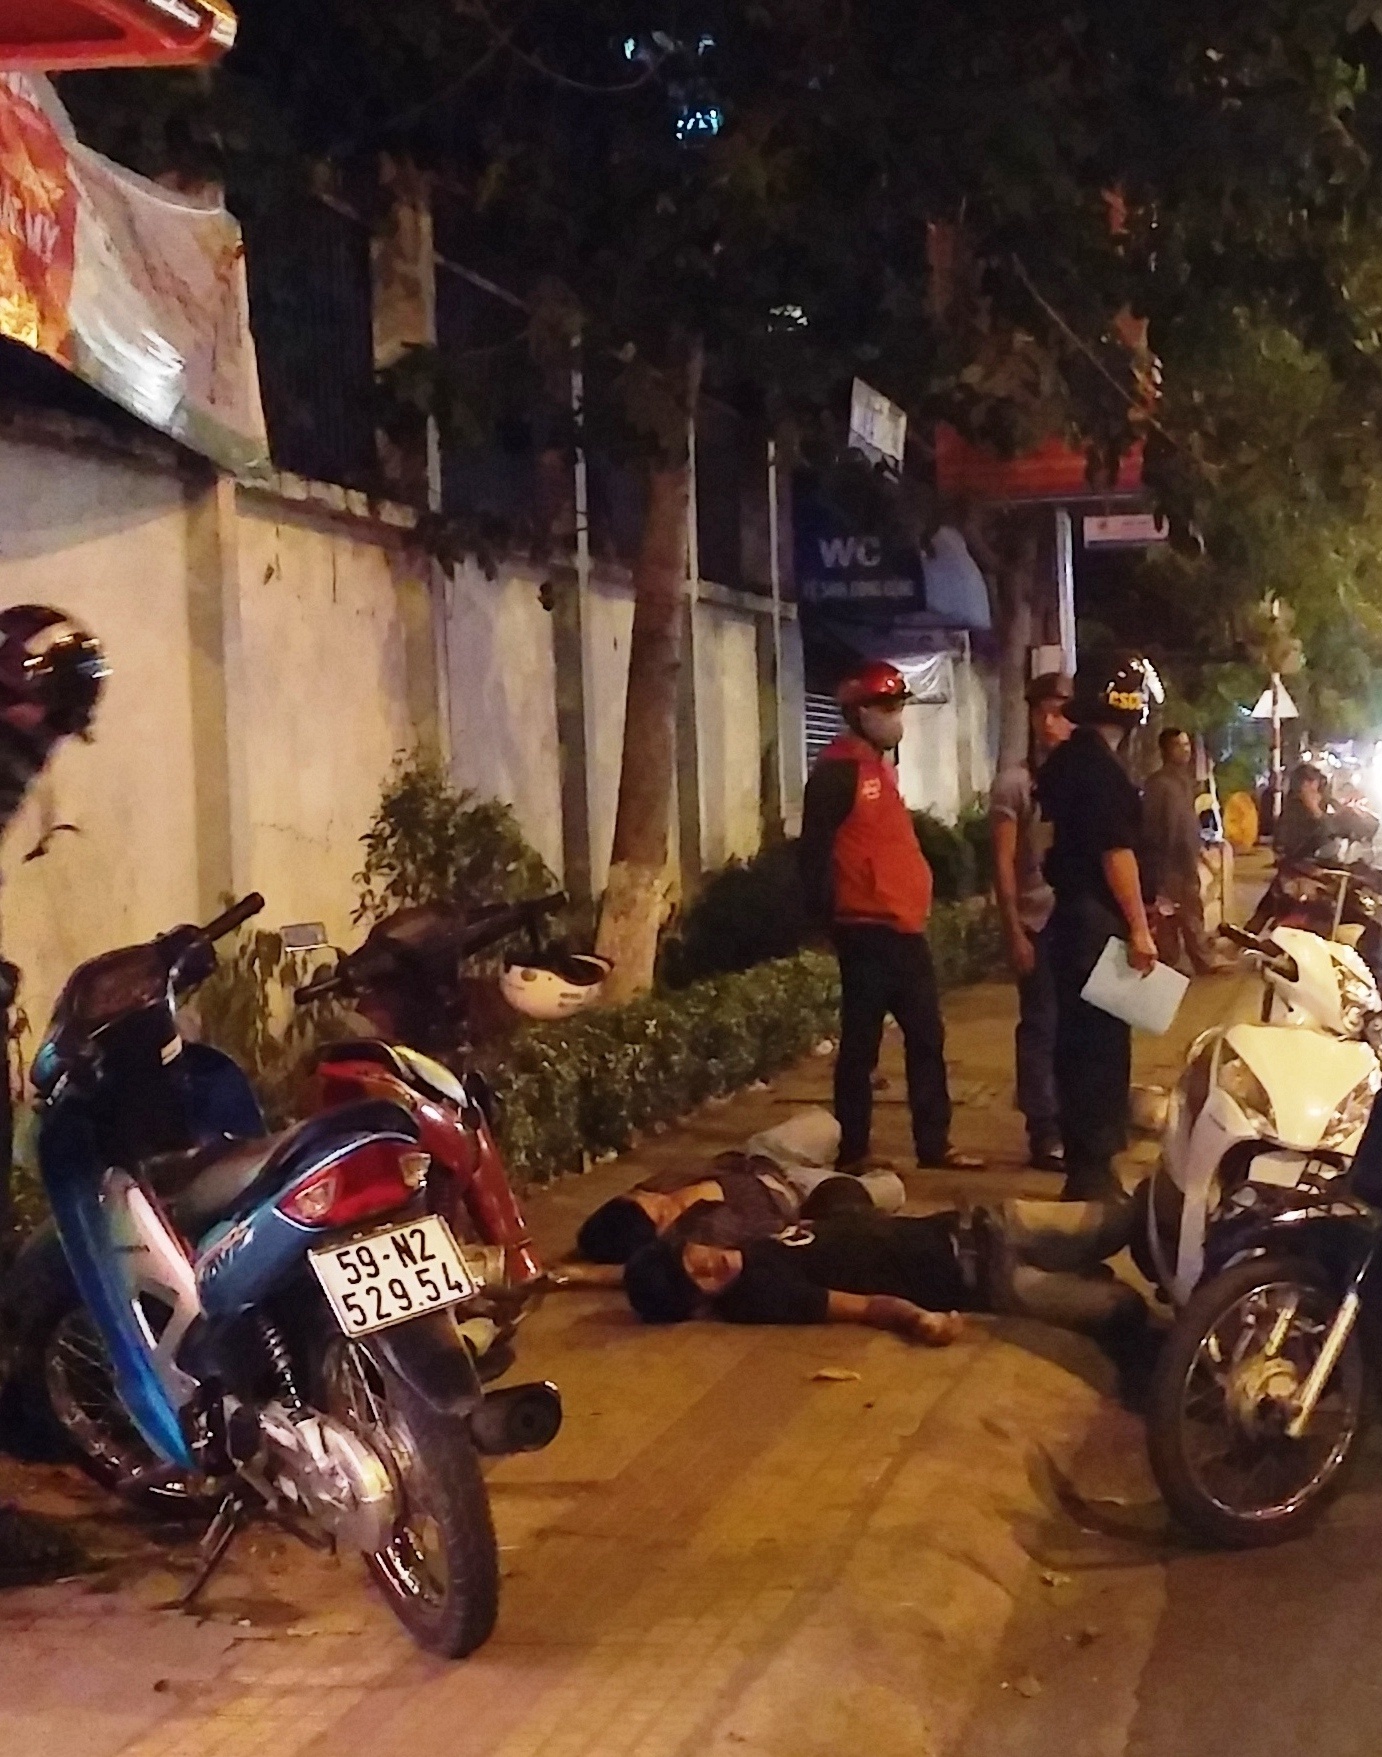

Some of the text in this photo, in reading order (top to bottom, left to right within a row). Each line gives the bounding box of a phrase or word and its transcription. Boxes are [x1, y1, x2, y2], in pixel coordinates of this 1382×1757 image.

[820, 537, 881, 568] WC
[336, 1229, 436, 1284] 59-N2
[342, 1262, 463, 1326] 529.54
